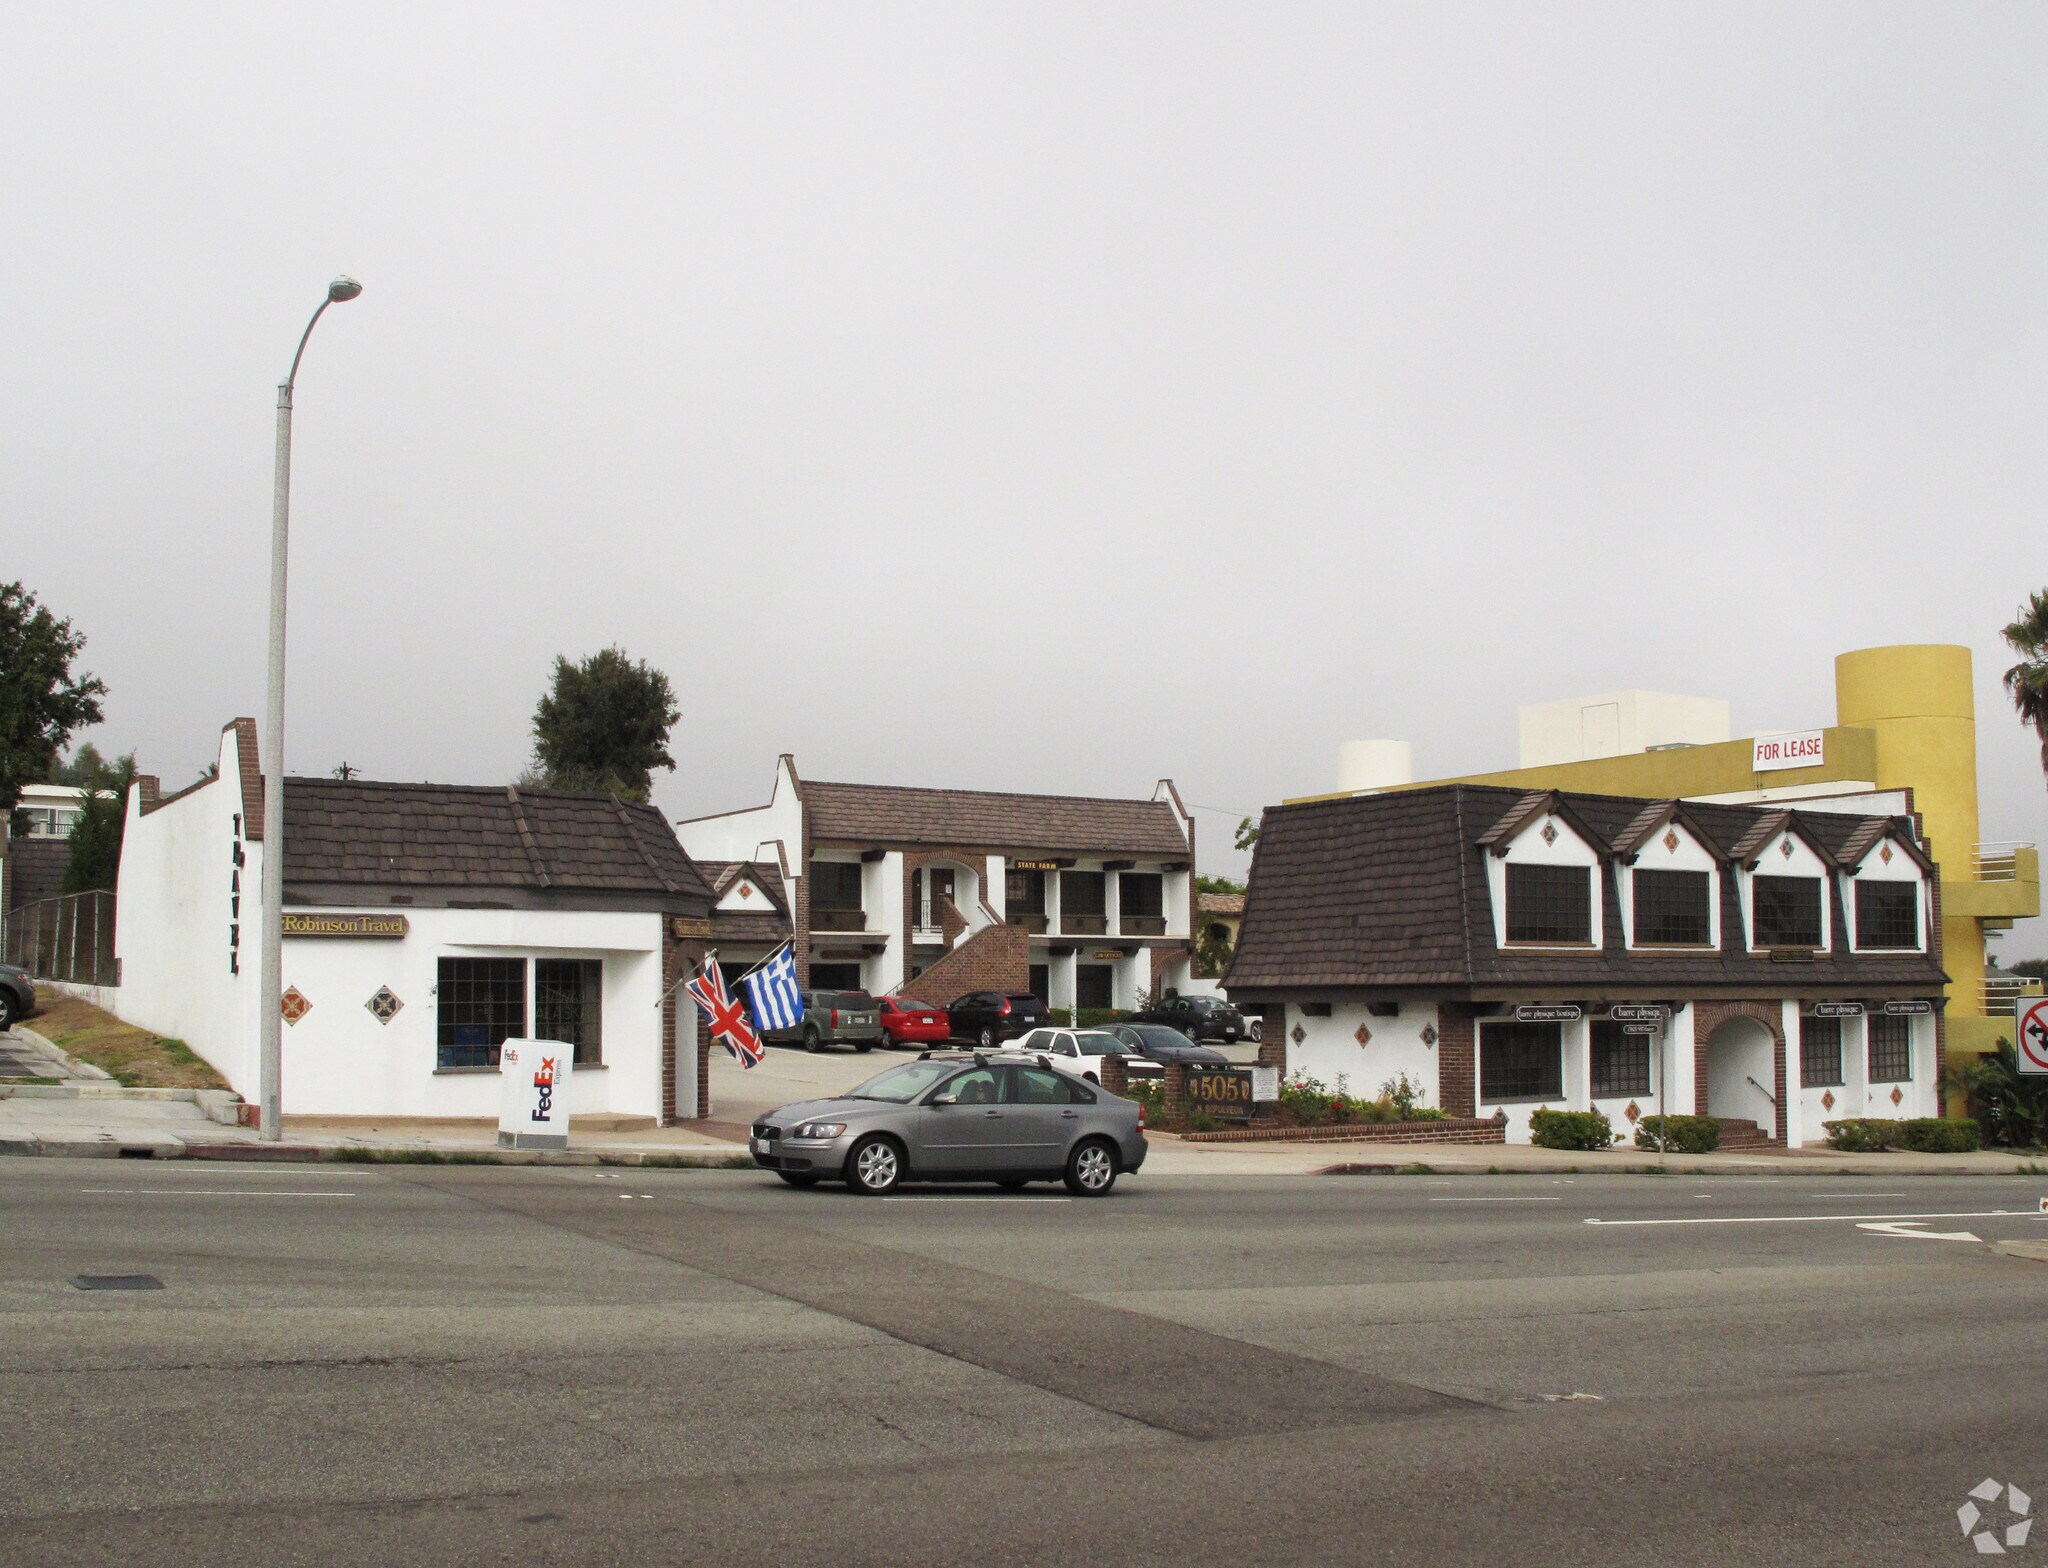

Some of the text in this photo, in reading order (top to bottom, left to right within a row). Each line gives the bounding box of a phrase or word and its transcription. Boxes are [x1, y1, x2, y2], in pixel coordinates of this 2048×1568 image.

[1757, 738, 1820, 760] FOR LEASE
[1018, 861, 1035, 869] STATE
[282, 915, 403, 932] Robinson Travel
[1618, 1007, 1660, 1019] barre physiqu
[532, 1056, 554, 1121] FedEx
[1201, 1075, 1238, 1100] 505
